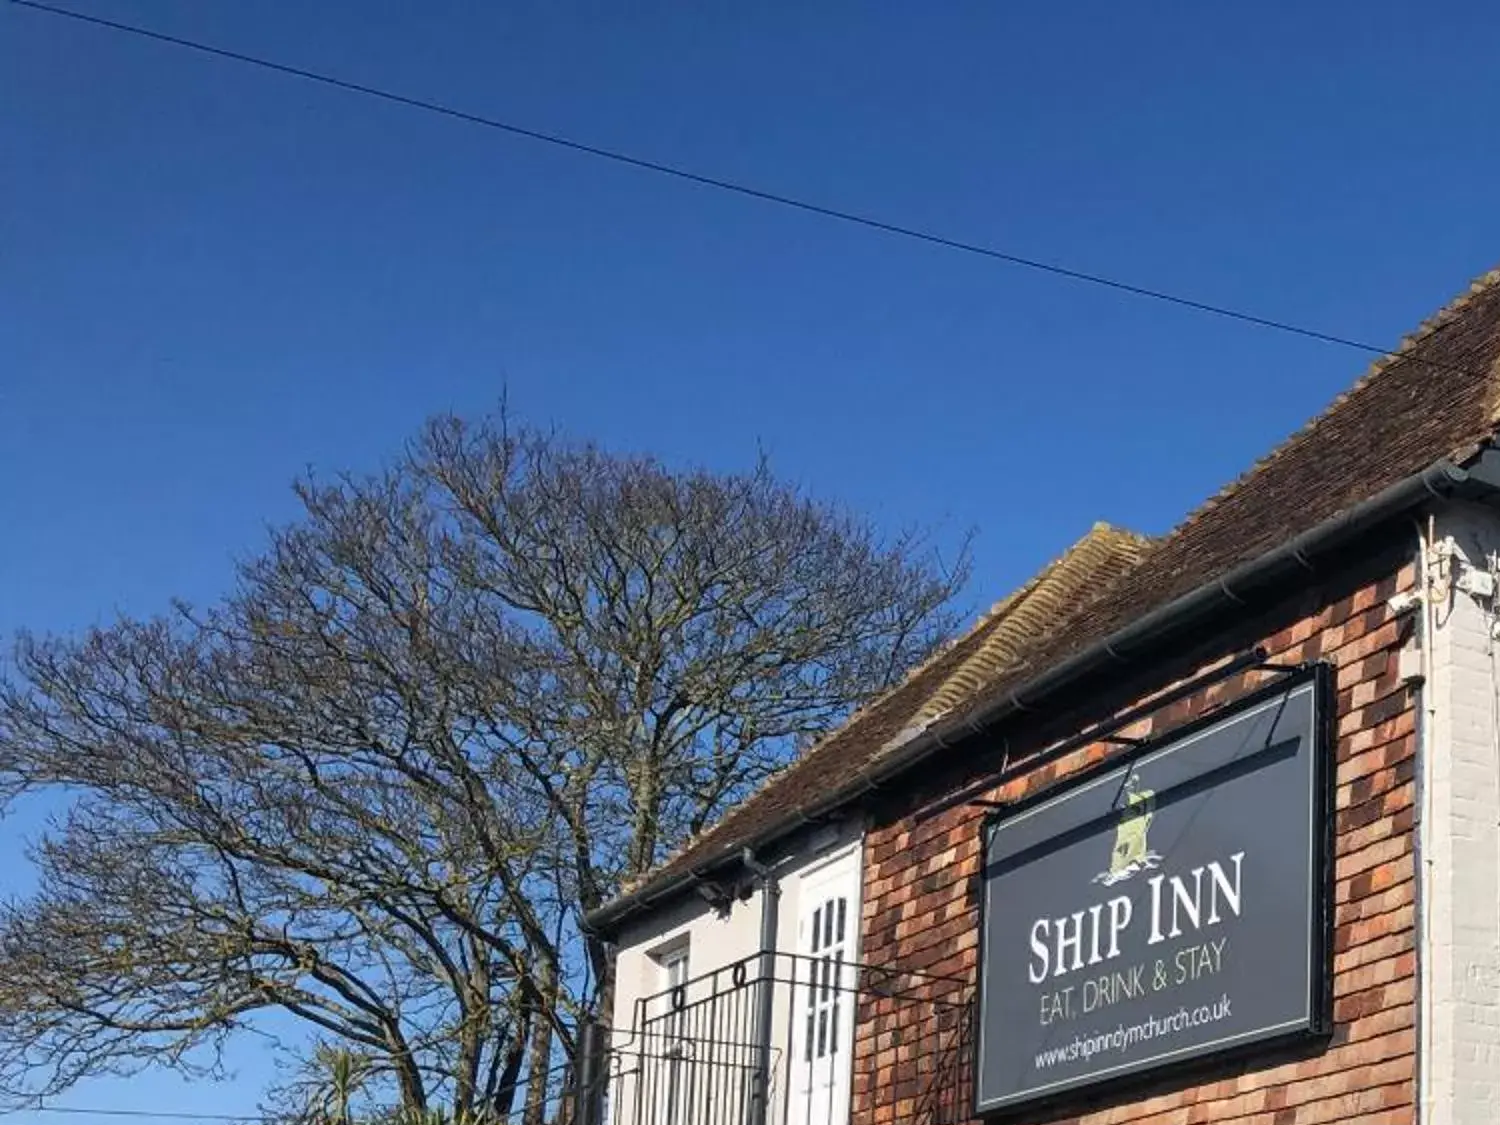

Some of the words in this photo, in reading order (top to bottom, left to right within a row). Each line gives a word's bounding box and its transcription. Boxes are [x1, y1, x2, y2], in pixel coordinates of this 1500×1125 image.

[1029, 895, 1132, 984] SHIP
[1147, 852, 1245, 945] INN
[1083, 963, 1145, 1013] DRINK
[1152, 959, 1167, 991] &
[1175, 937, 1227, 985] STAY
[1035, 992, 1231, 1070] www.shipinndymchurch.co.uk
